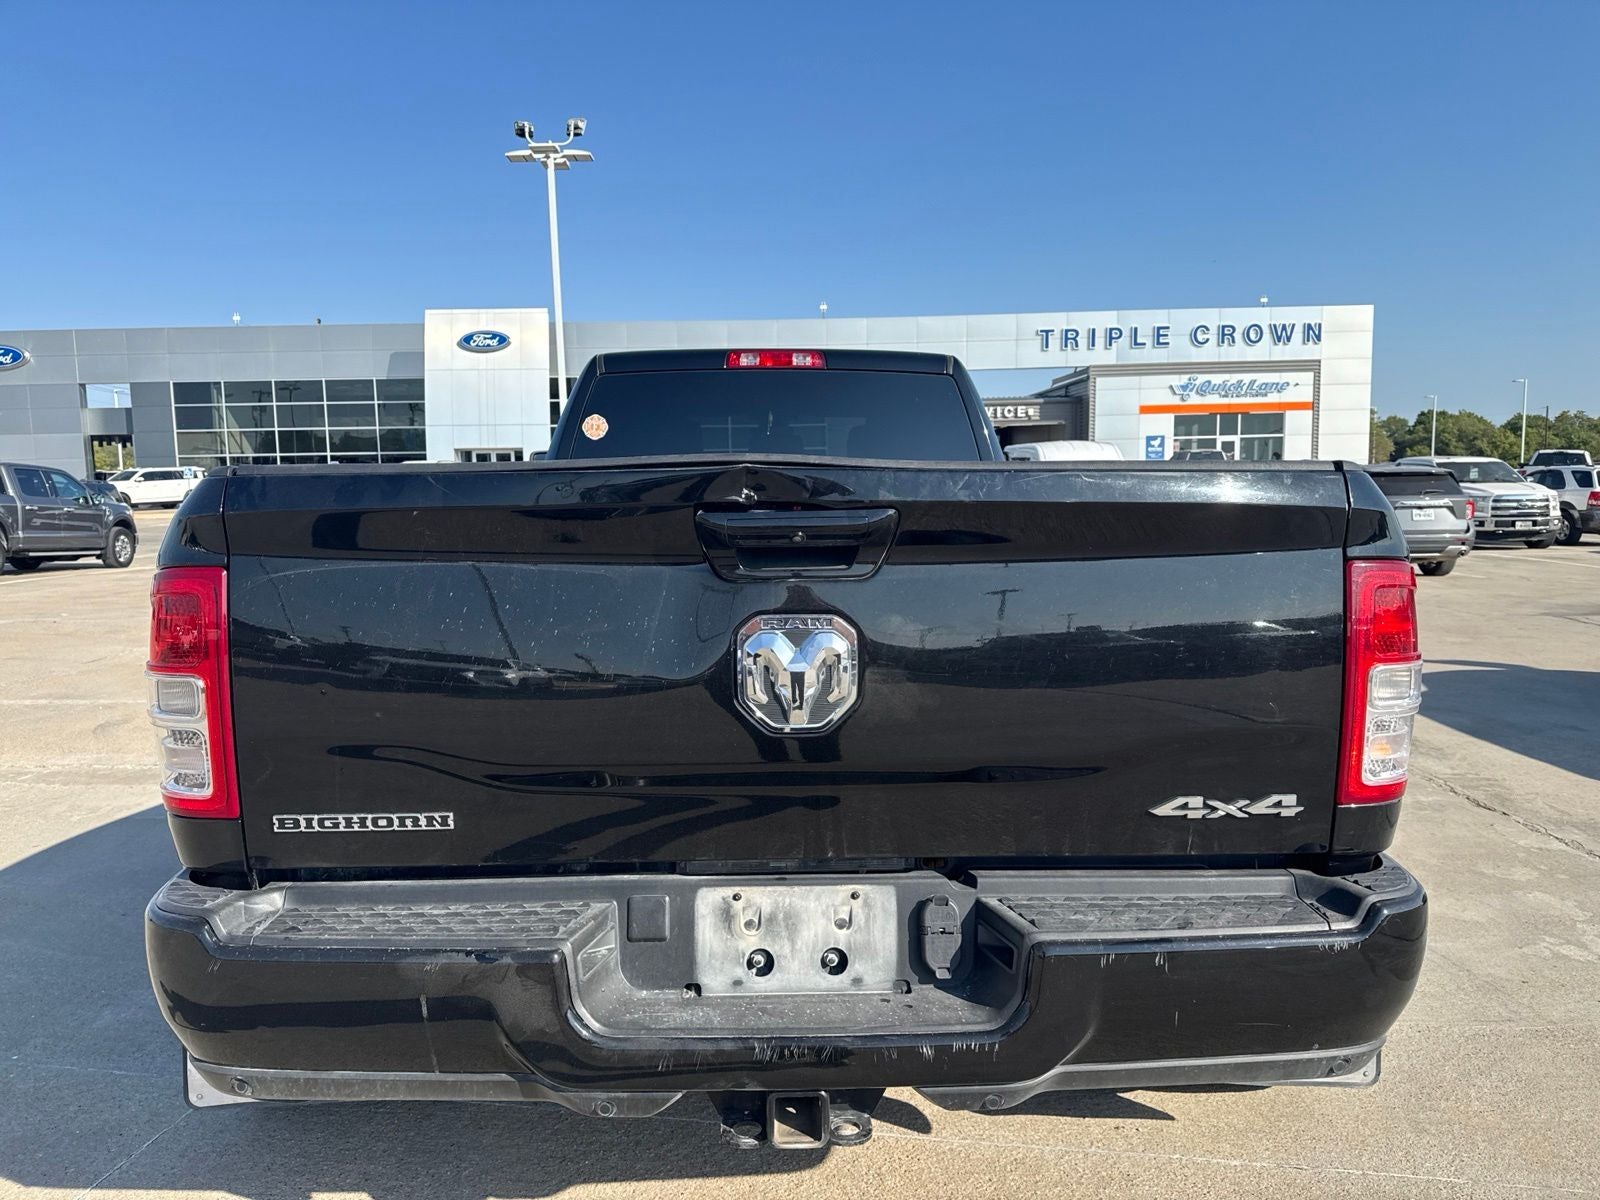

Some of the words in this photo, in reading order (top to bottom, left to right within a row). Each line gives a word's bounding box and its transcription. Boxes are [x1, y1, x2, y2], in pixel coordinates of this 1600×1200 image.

[470, 333, 500, 347] Ford
[1038, 325, 1171, 350] TRIPLE
[1192, 321, 1323, 346] CROWN
[761, 618, 833, 629] RAM
[1148, 794, 1305, 819] 4x4
[272, 812, 455, 832] BIGHORN
